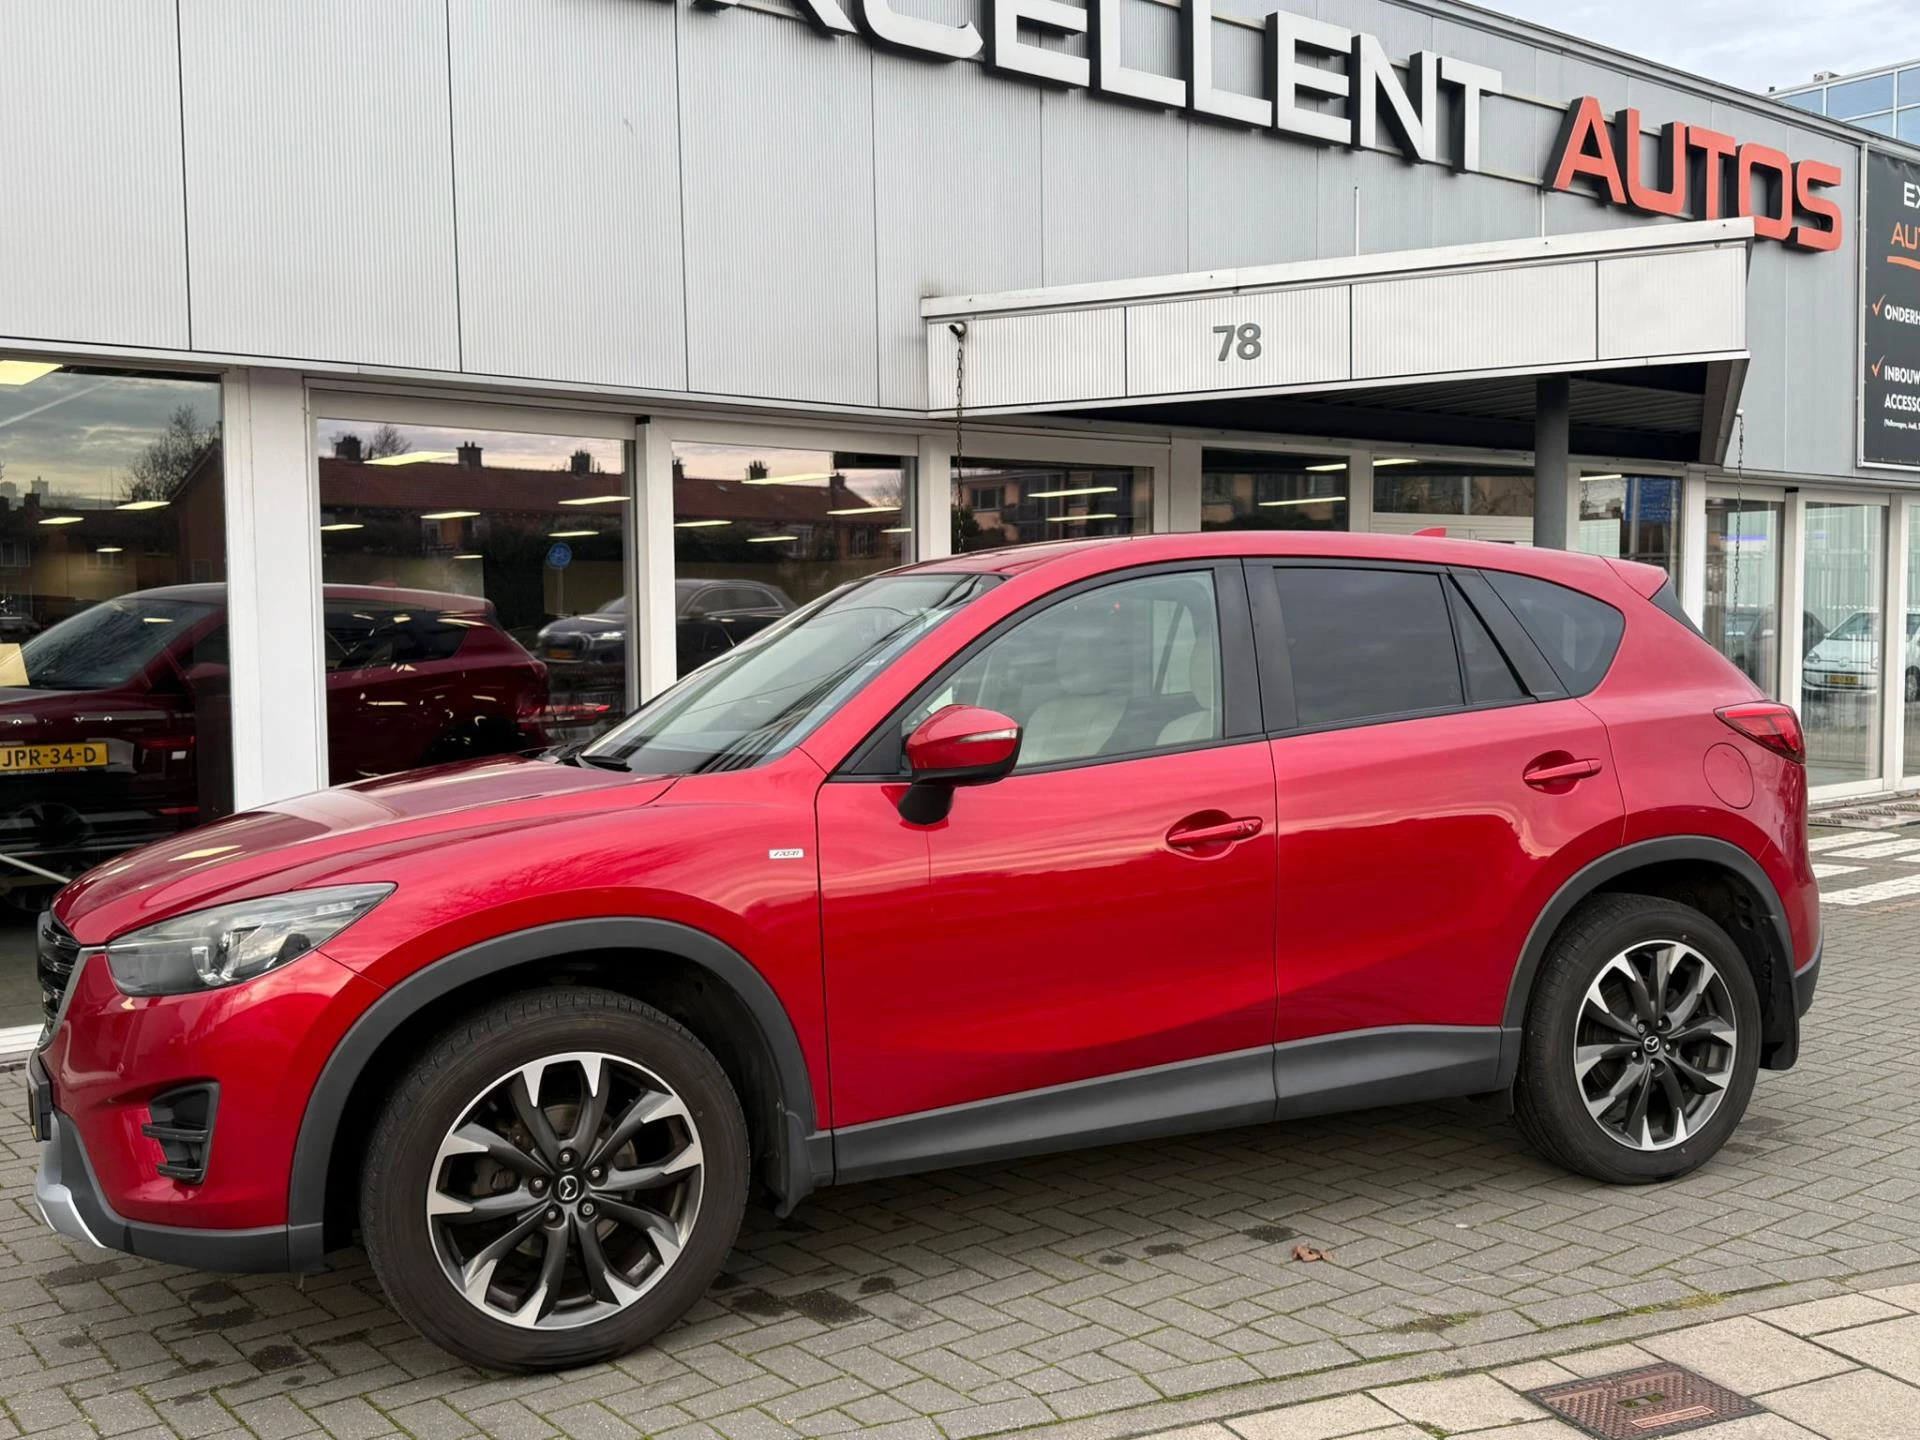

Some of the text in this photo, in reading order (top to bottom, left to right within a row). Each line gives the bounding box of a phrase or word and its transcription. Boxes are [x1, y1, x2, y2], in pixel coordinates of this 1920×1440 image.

[712, 0, 1842, 251] ELLENT AUTOS
[1890, 221, 1920, 250] AU
[1213, 322, 1262, 361] 78
[2, 747, 97, 767] JPR-34-D
